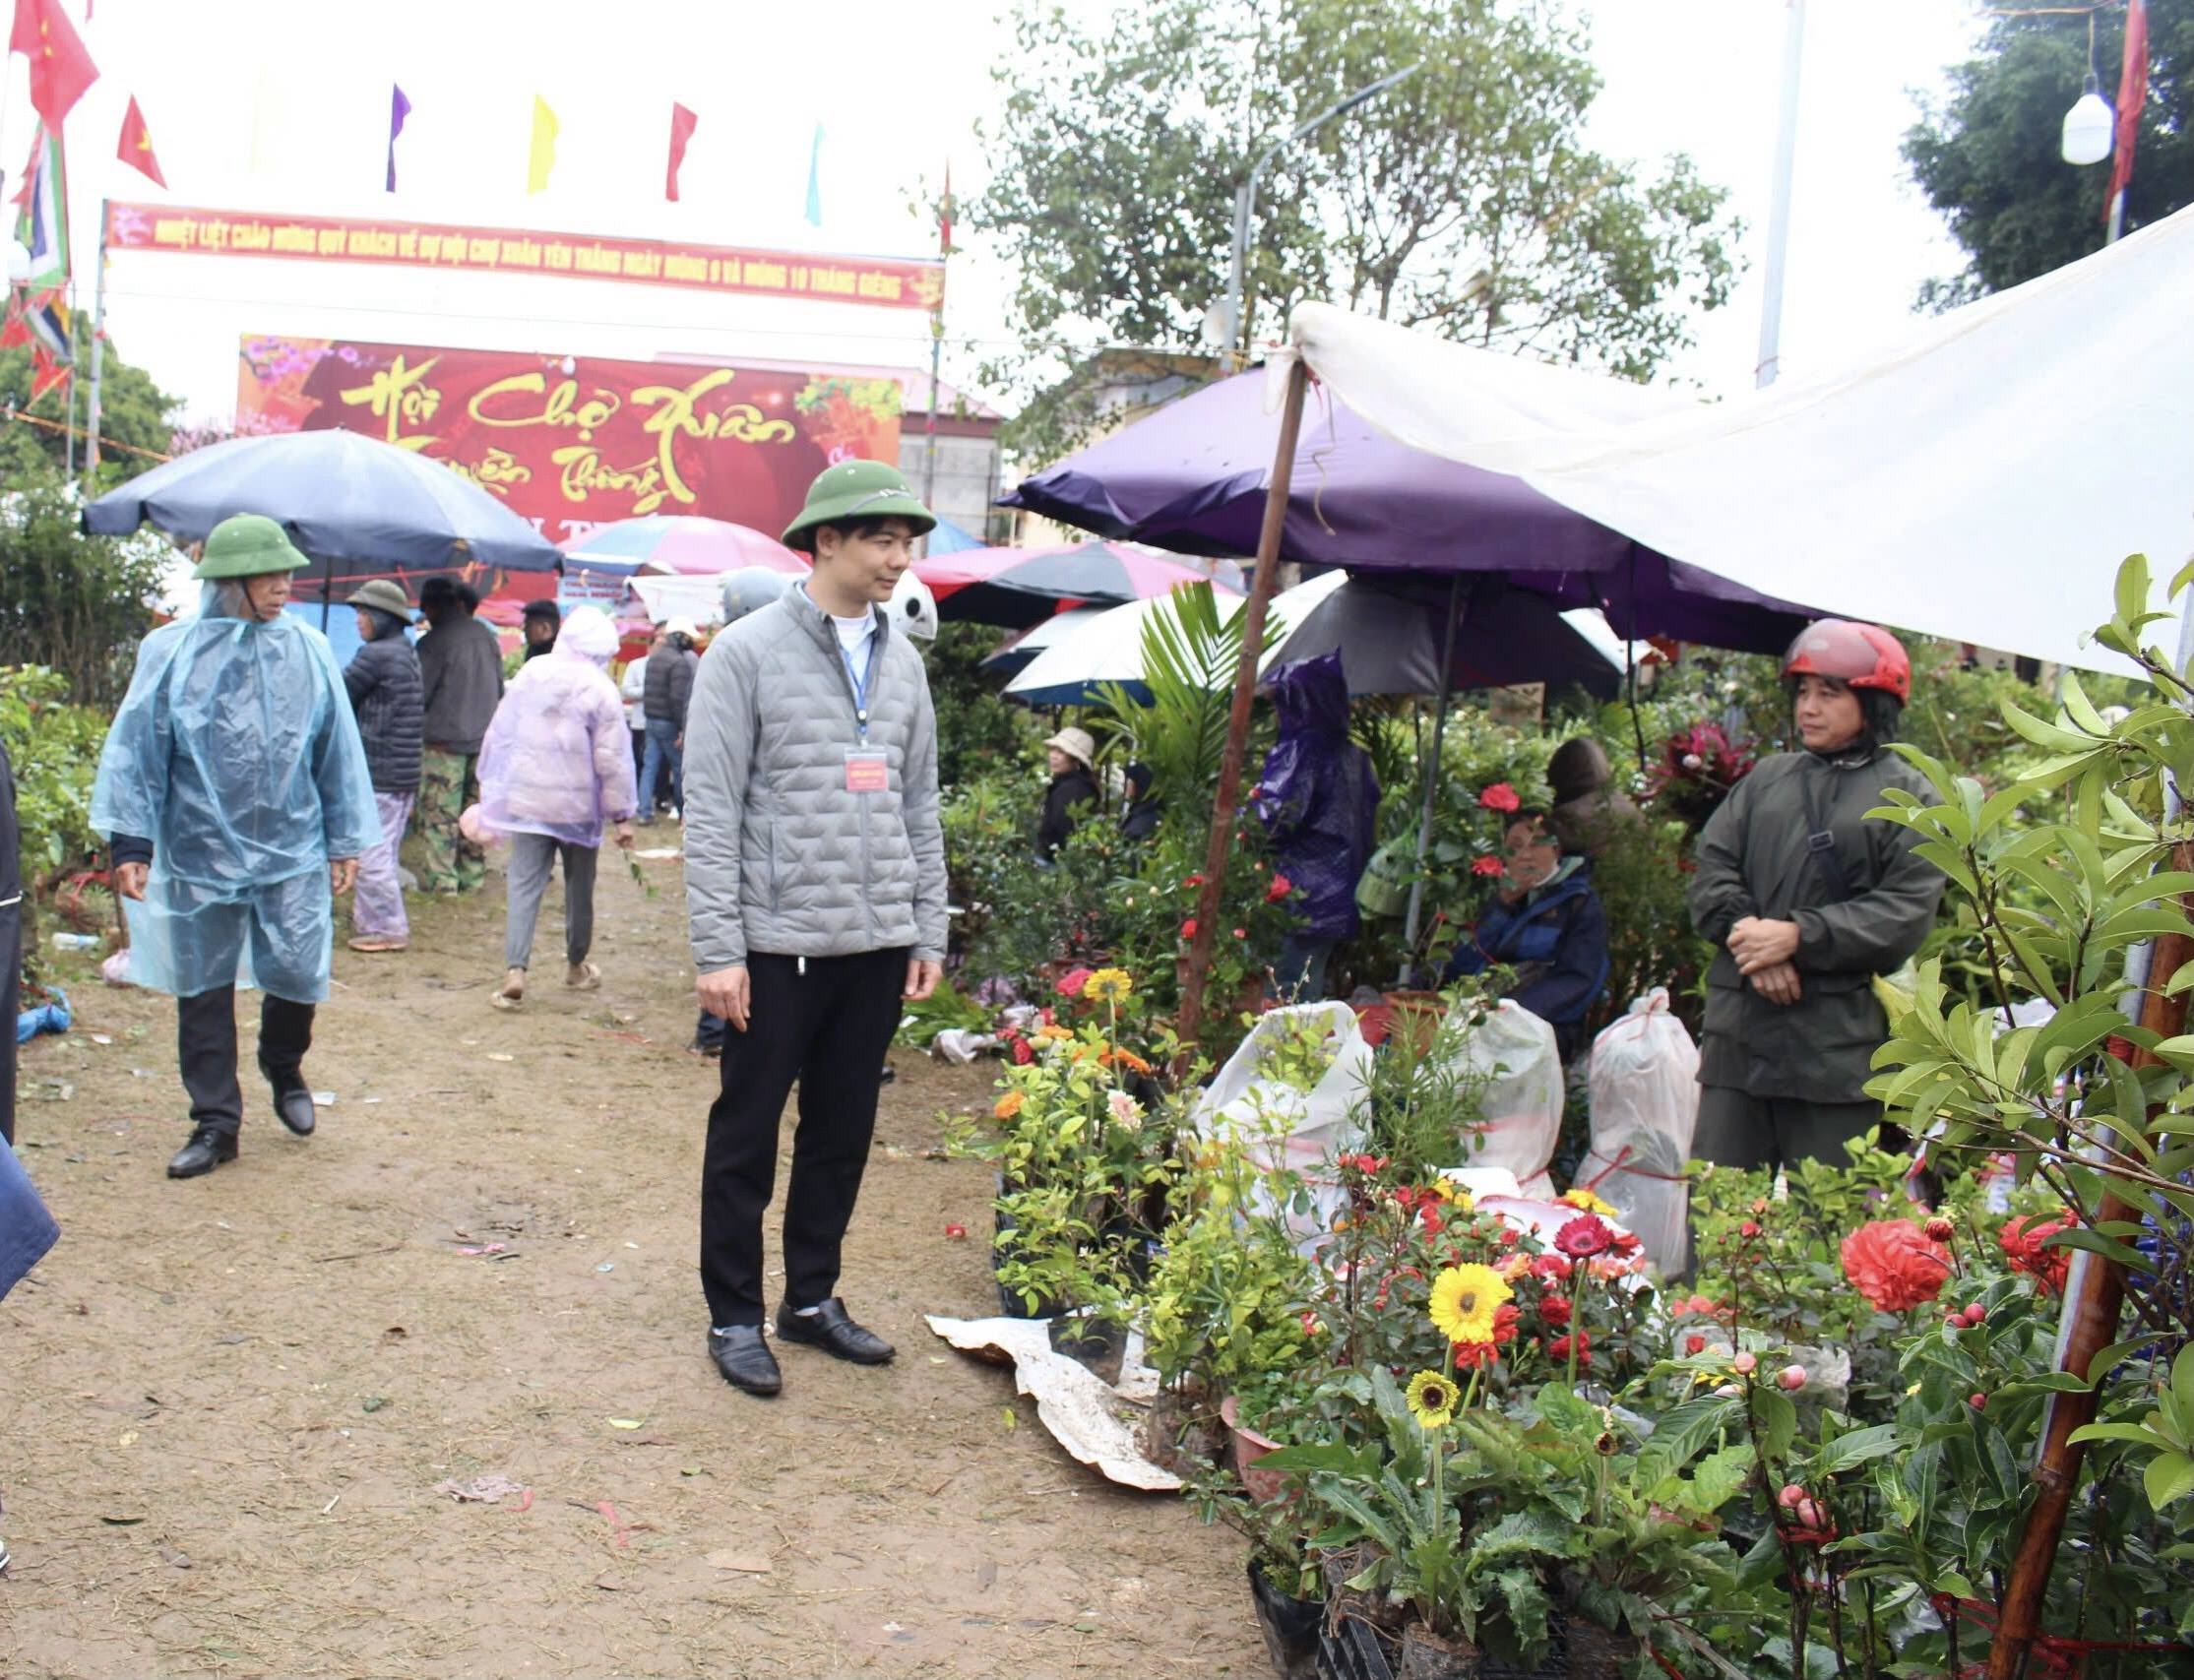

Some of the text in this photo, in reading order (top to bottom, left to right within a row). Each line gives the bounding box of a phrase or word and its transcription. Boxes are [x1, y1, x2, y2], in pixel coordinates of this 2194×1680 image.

[231, 219, 270, 250] CHÀO
[339, 354, 795, 505] Hội Chợ Xuân
